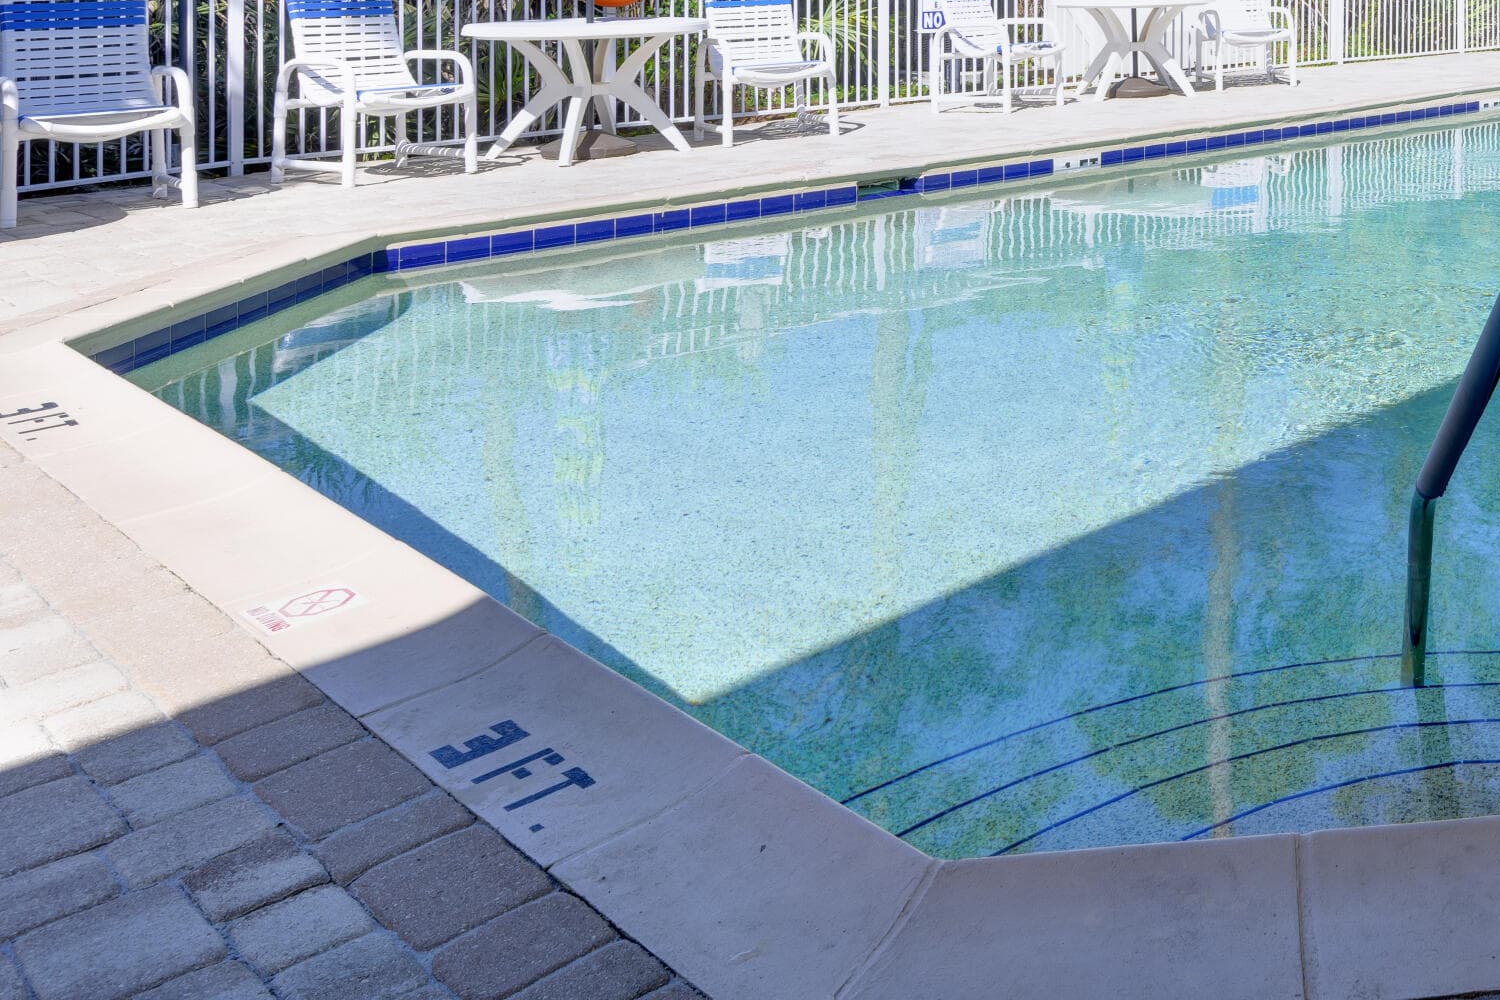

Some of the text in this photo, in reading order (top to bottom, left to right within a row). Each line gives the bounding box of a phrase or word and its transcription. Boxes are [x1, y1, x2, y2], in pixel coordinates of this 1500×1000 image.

[924, 13, 943, 29] NO
[1080, 157, 1098, 166] FT
[428, 719, 531, 770] 3
